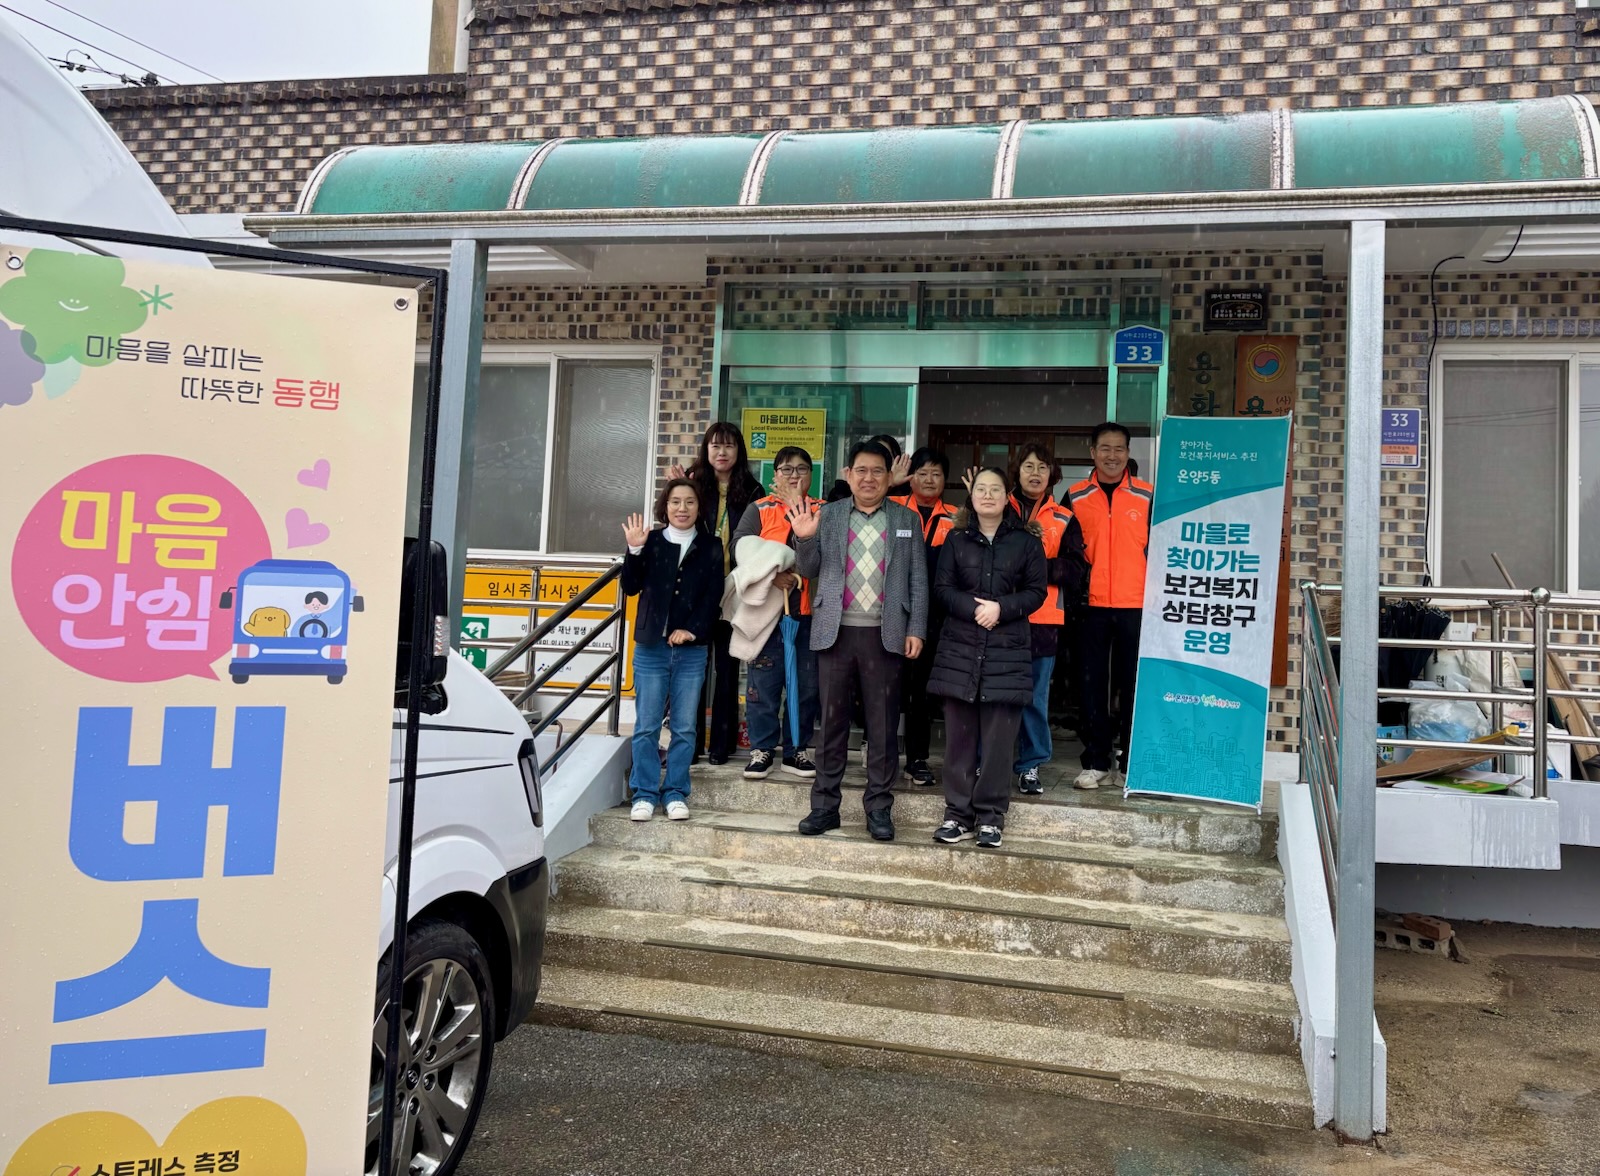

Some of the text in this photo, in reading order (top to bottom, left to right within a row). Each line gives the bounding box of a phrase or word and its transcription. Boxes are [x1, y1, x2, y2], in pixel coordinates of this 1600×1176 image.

[85, 335, 264, 372] 마음을 살피는
[1126, 345, 1153, 361] 33
[181, 376, 340, 410] 따뜻한 동행
[760, 414, 808, 425] 마을대피소
[1391, 413, 1409, 427] 33
[1179, 451, 1258, 462] 보건복지서비스 추진
[1180, 440, 1213, 450] 찾아가는
[1177, 469, 1221, 485] 온양5동
[59, 490, 228, 570] 마음
[1180, 521, 1251, 545] 마을로
[1166, 546, 1260, 573] 찾아가는
[488, 581, 580, 599] 임시주거시설
[1163, 573, 1258, 600] 보건복지
[52, 573, 213, 651] 안심
[1162, 600, 1256, 628] 상담창구
[558, 626, 571, 635] 재난
[574, 626, 587, 635] 발생
[1183, 629, 1231, 655] 운영
[48, 706, 286, 1084] 버스
[91, 1150, 240, 1176] 스트레스 측정
